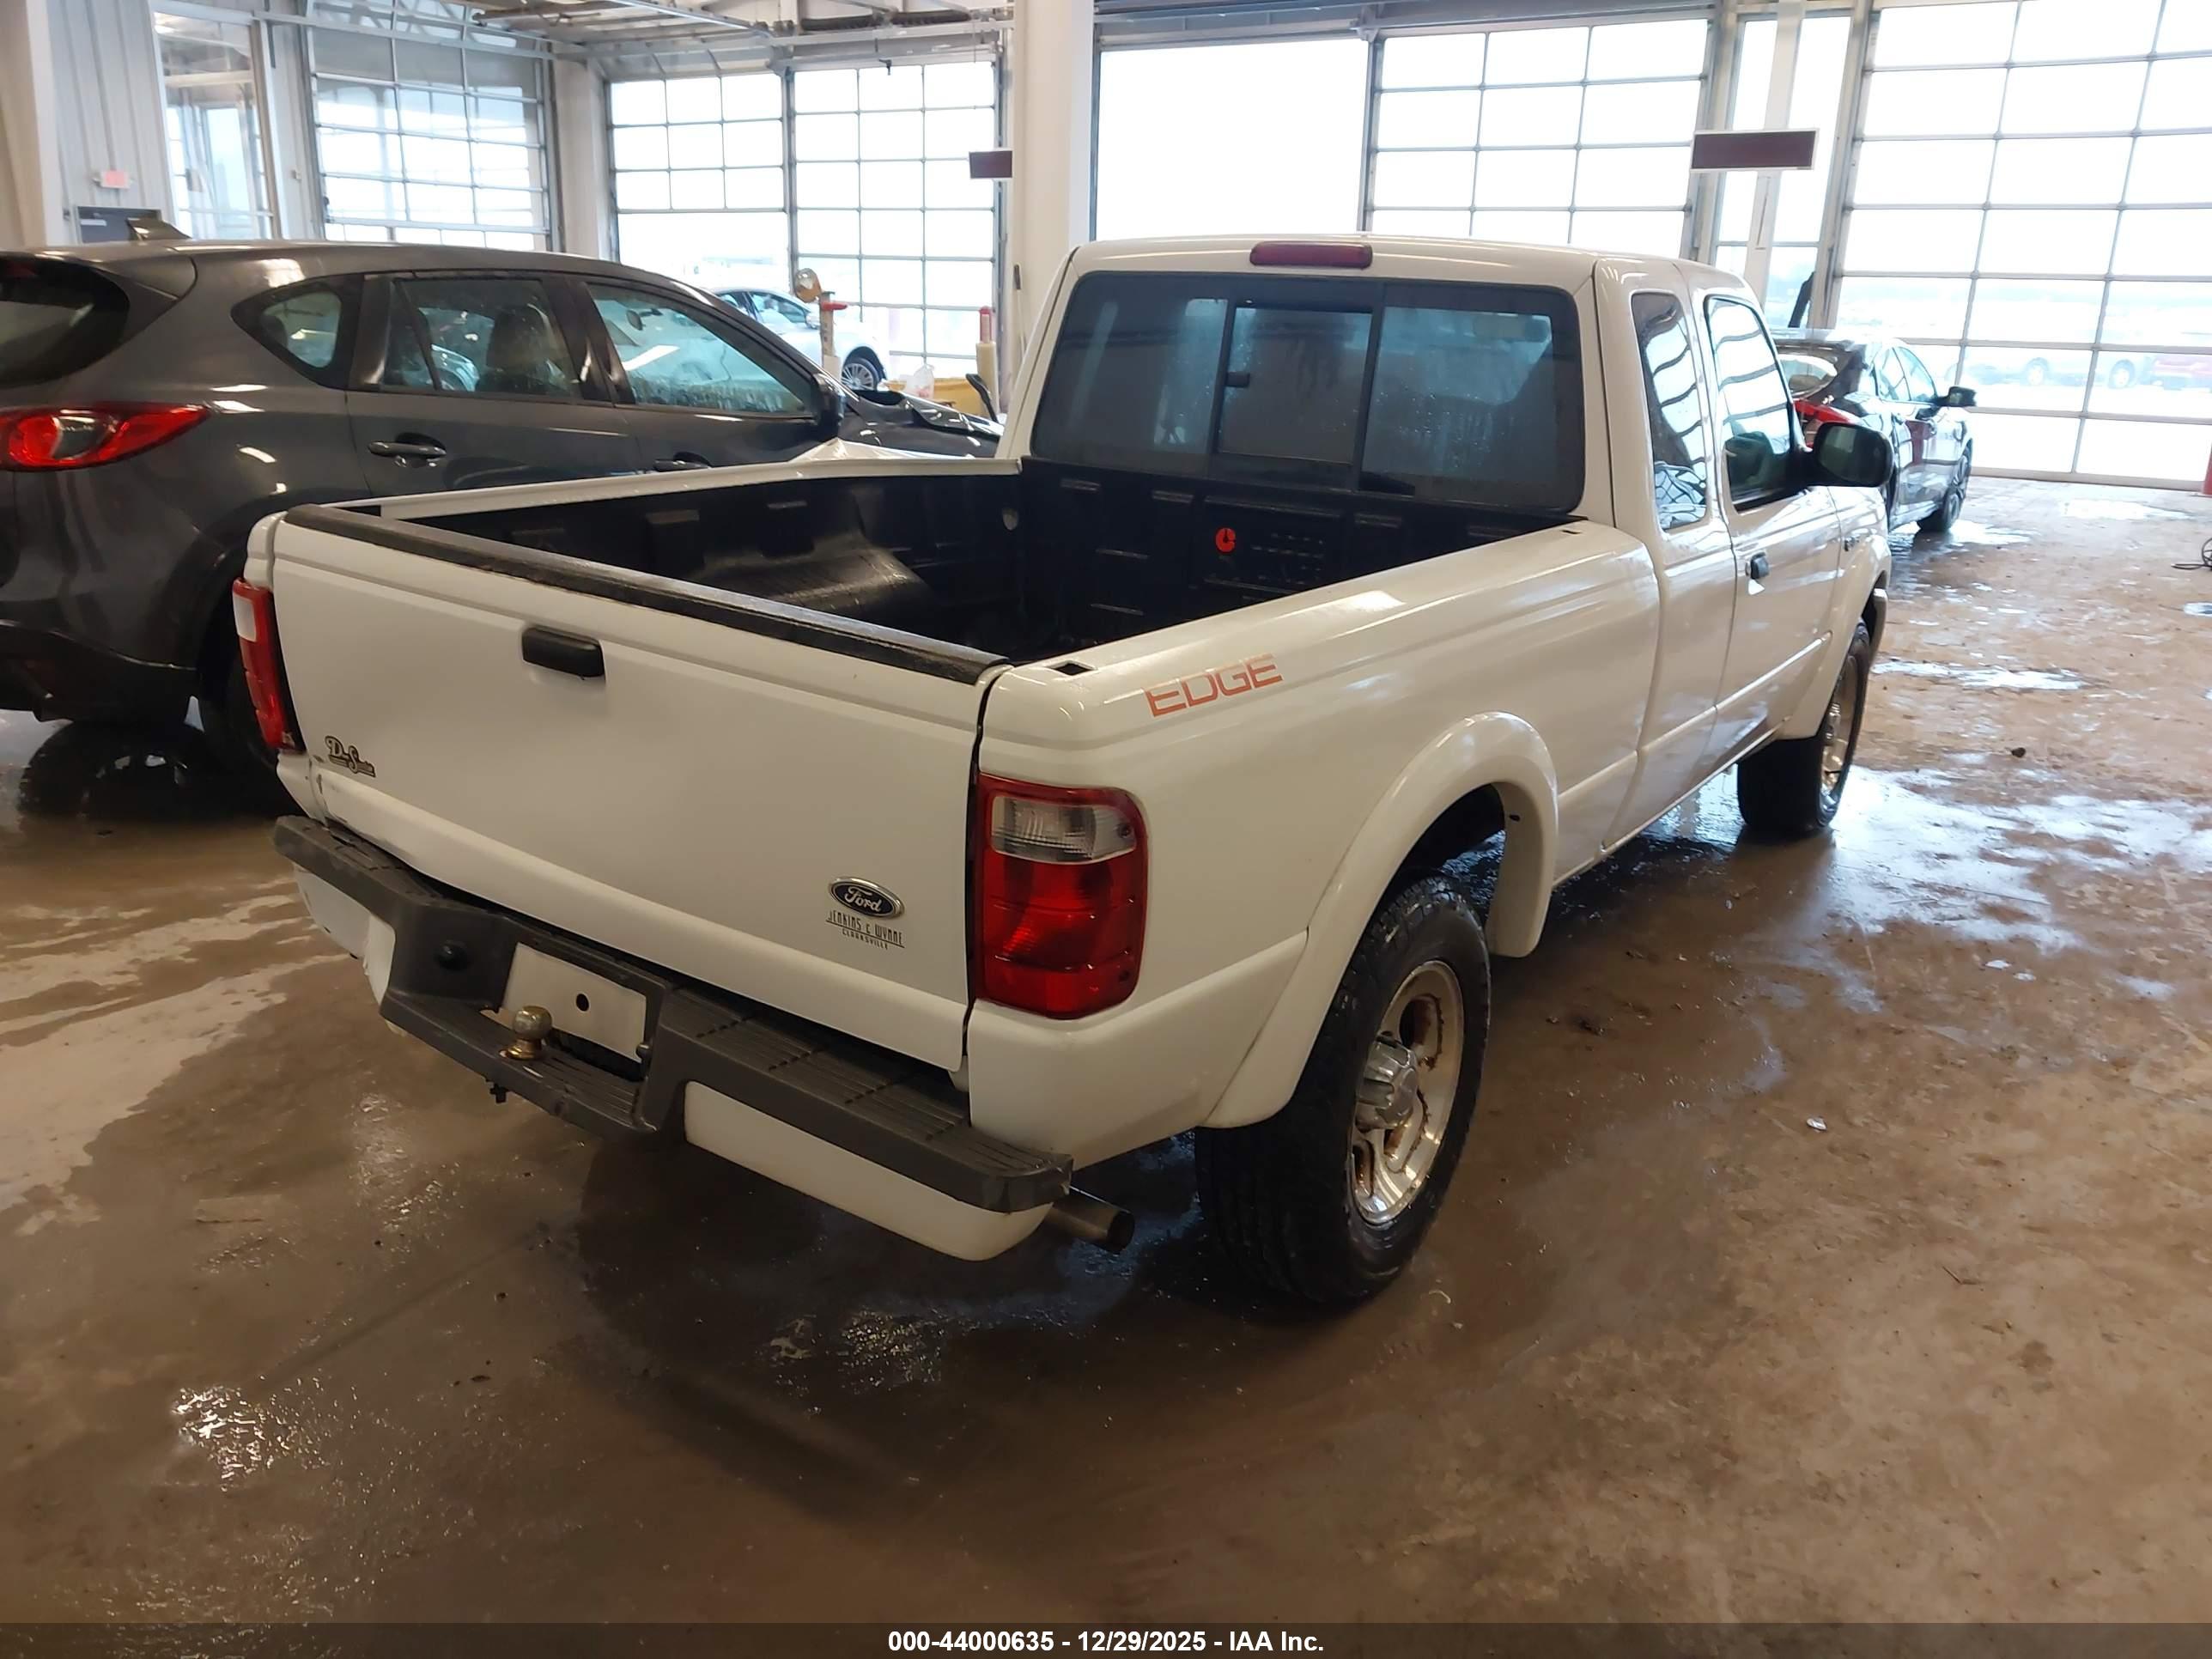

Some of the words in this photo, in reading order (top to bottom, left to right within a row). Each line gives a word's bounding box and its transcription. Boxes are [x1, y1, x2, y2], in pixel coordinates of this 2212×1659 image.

[1145, 653, 1283, 717] EDGE
[844, 886, 882, 912] Ford
[828, 910, 861, 931] JENKINS
[875, 924, 902, 945] WYNNE
[842, 928, 888, 951] CLARKSVILLE
